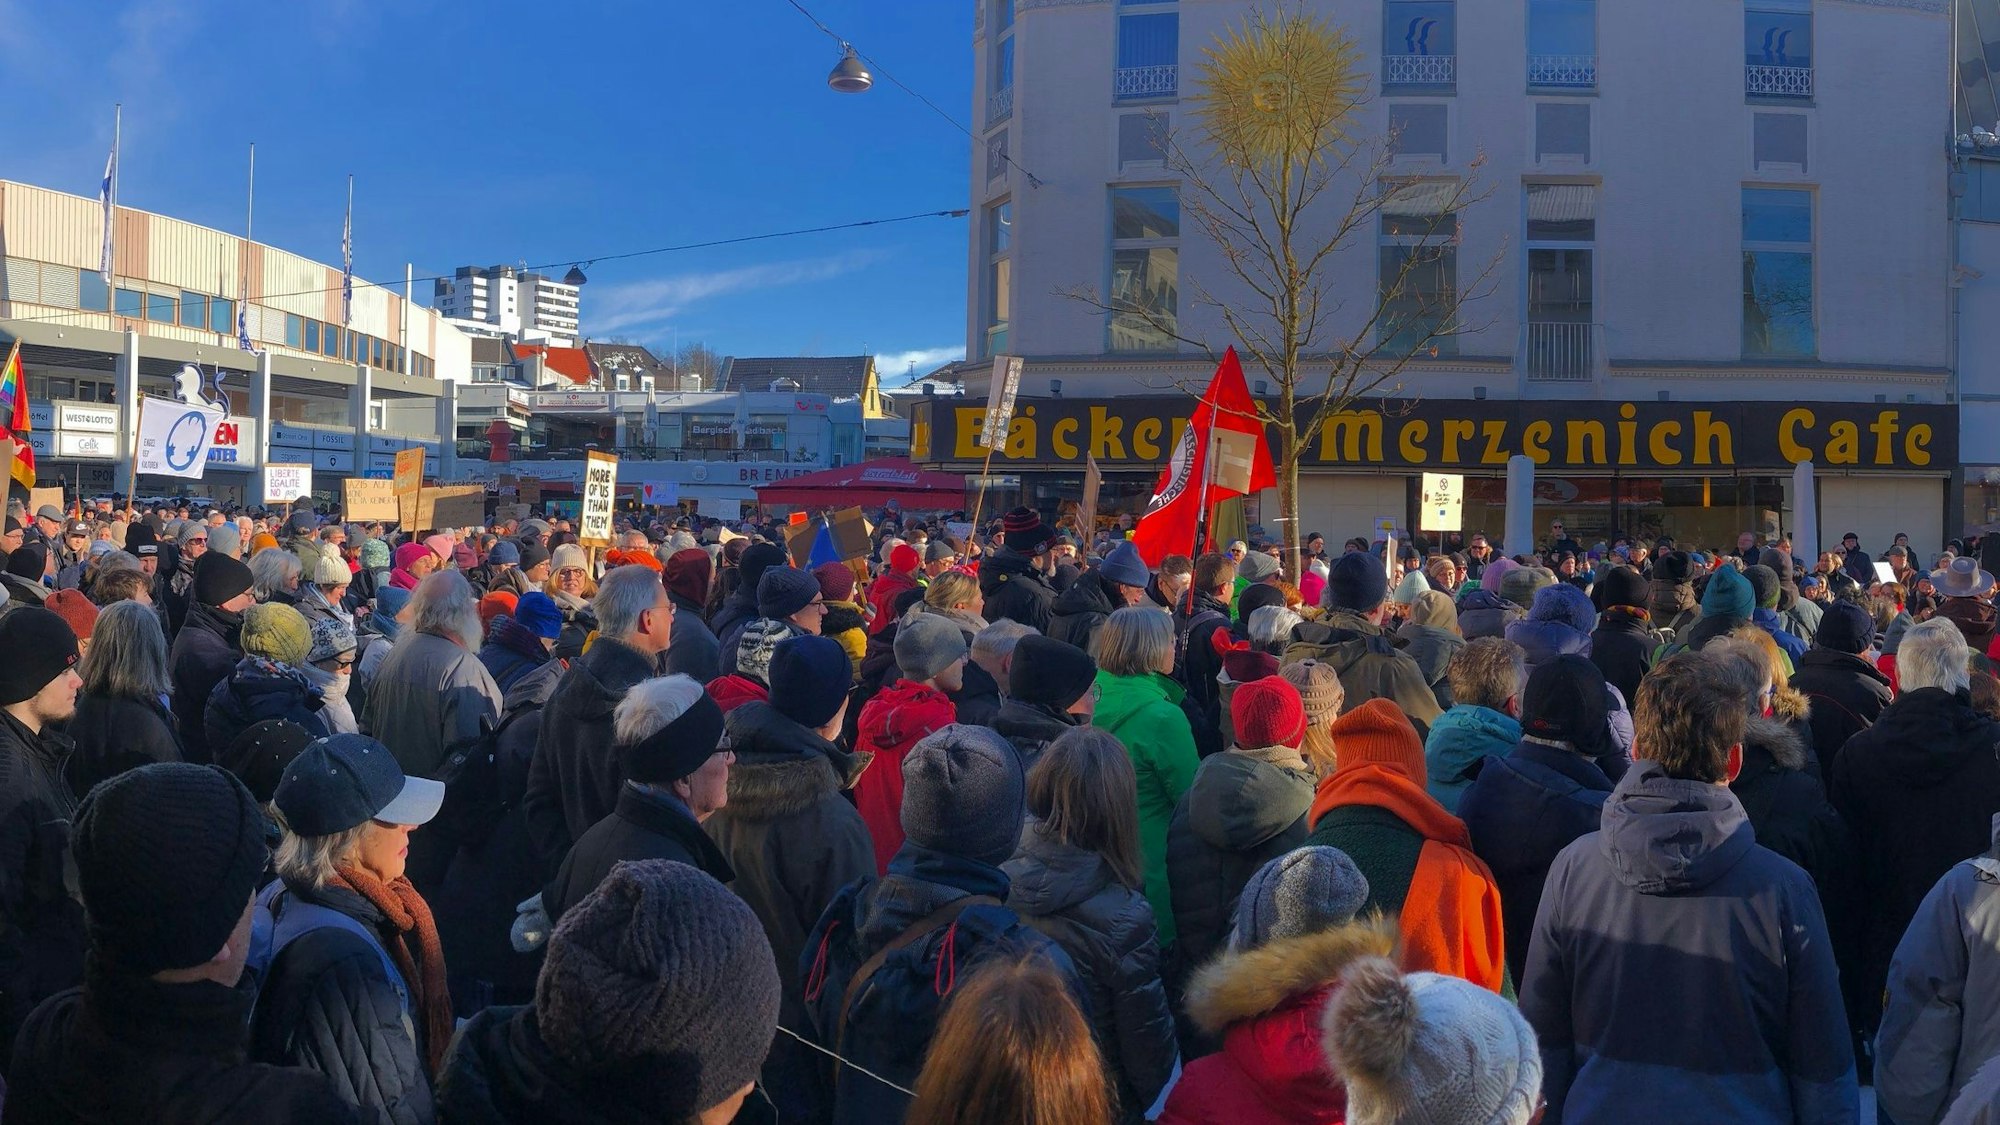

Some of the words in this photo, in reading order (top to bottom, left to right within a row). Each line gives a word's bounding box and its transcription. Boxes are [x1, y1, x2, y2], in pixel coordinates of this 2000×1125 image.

[214, 422, 238, 446] EN
[1157, 424, 1197, 508] FASCHISTISCHE
[589, 468, 611, 483] MORE
[588, 484, 598, 497] OF
[600, 485, 609, 498] US
[588, 500, 609, 513] THAN
[585, 516, 608, 529] THEM
